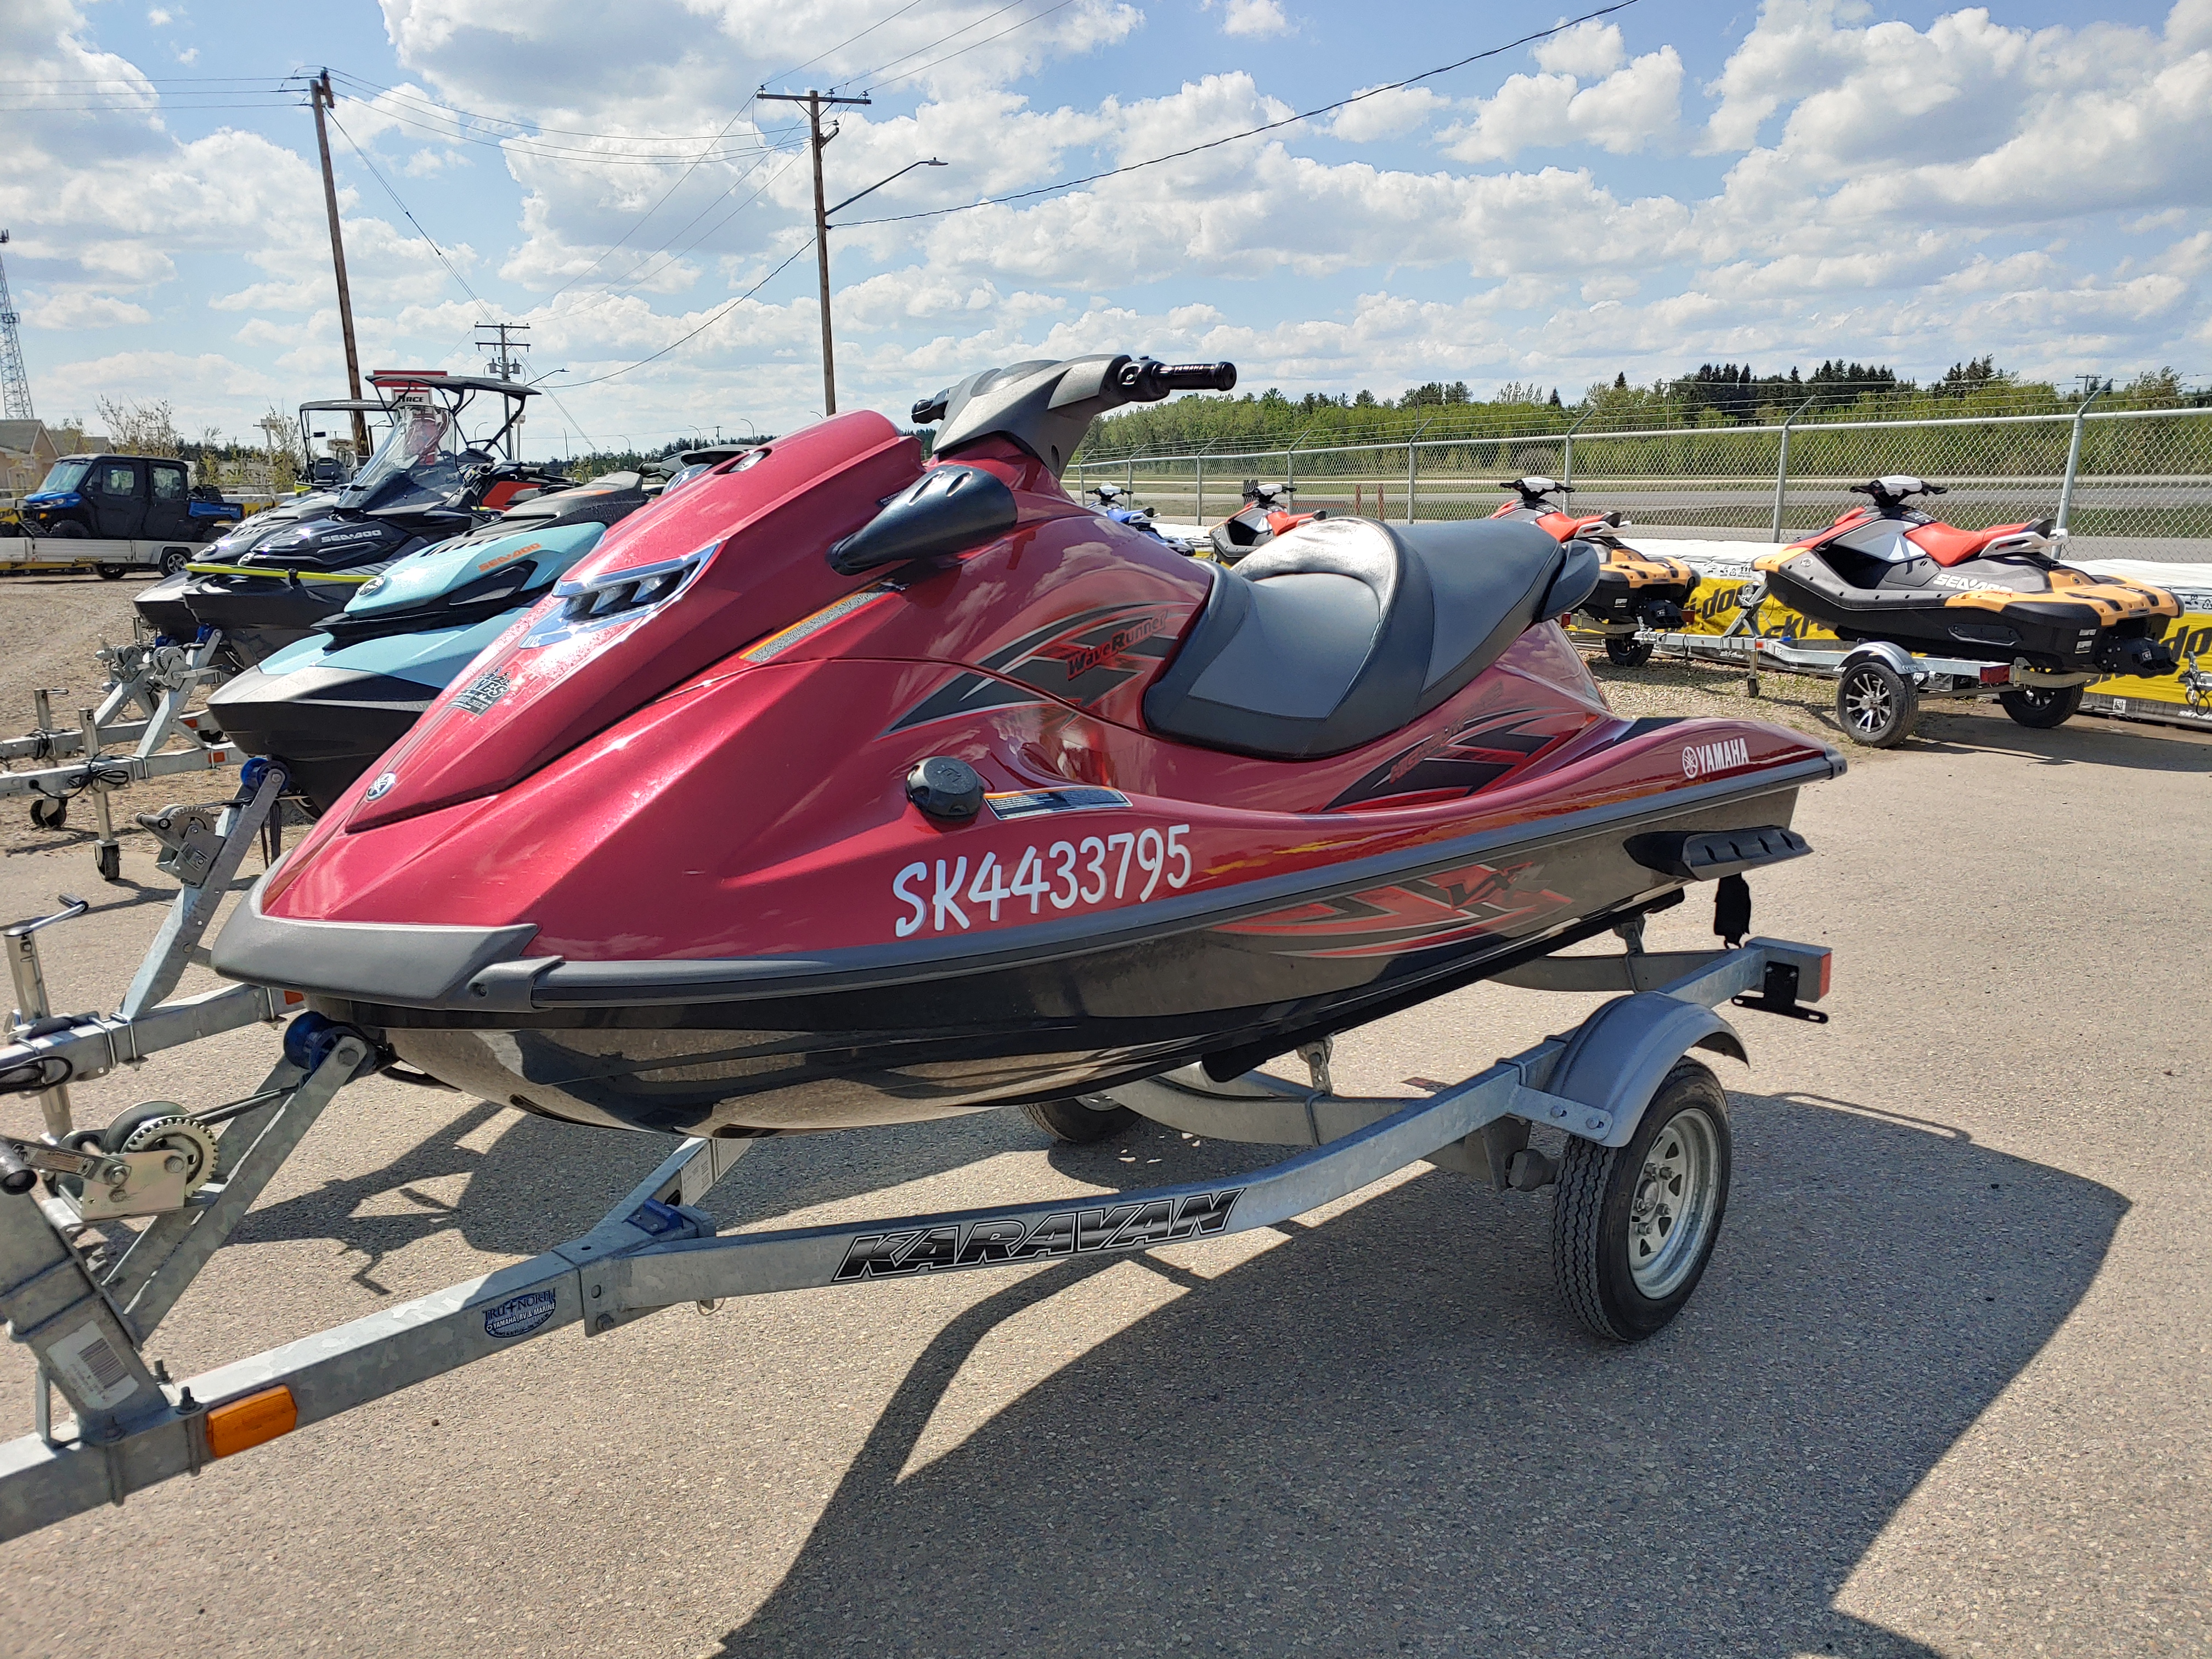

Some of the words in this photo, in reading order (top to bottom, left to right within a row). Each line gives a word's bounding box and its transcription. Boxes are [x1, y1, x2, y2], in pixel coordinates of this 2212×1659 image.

[1173, 364, 1204, 374] YAMAHA
[1696, 738, 1750, 774] YAMAHA
[893, 824, 1192, 938] SK4433795
[831, 1187, 1246, 1283] KARAVAN
[483, 1304, 505, 1321] TRU
[518, 1287, 556, 1310] NORTH
[519, 1312, 527, 1321] RV
[534, 1302, 556, 1316] MARINE
